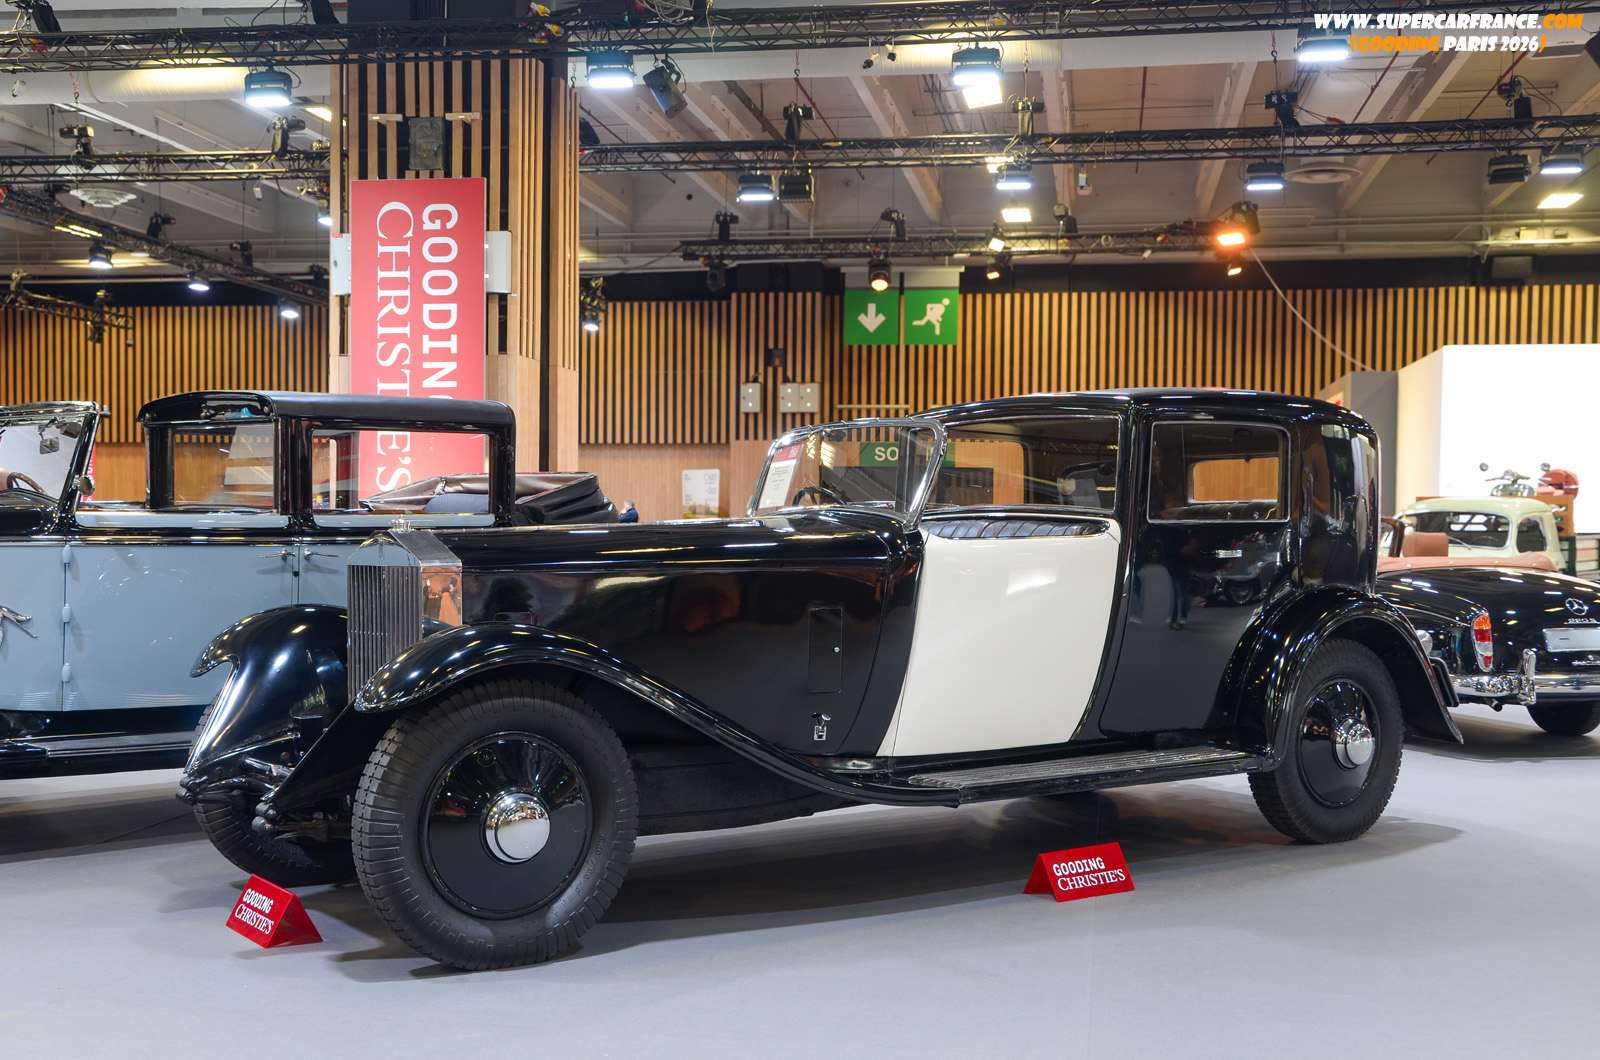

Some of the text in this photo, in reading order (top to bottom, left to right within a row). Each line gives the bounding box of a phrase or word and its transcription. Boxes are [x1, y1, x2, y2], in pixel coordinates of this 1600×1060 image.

[421, 203, 458, 400] GOODIN
[376, 201, 414, 492] CHRISTE'S
[1053, 857, 1105, 877] GOODING
[1057, 868, 1126, 891] CHRISTIE'S
[243, 888, 274, 914] GOODING
[234, 903, 275, 935] CHRISTIE'S
